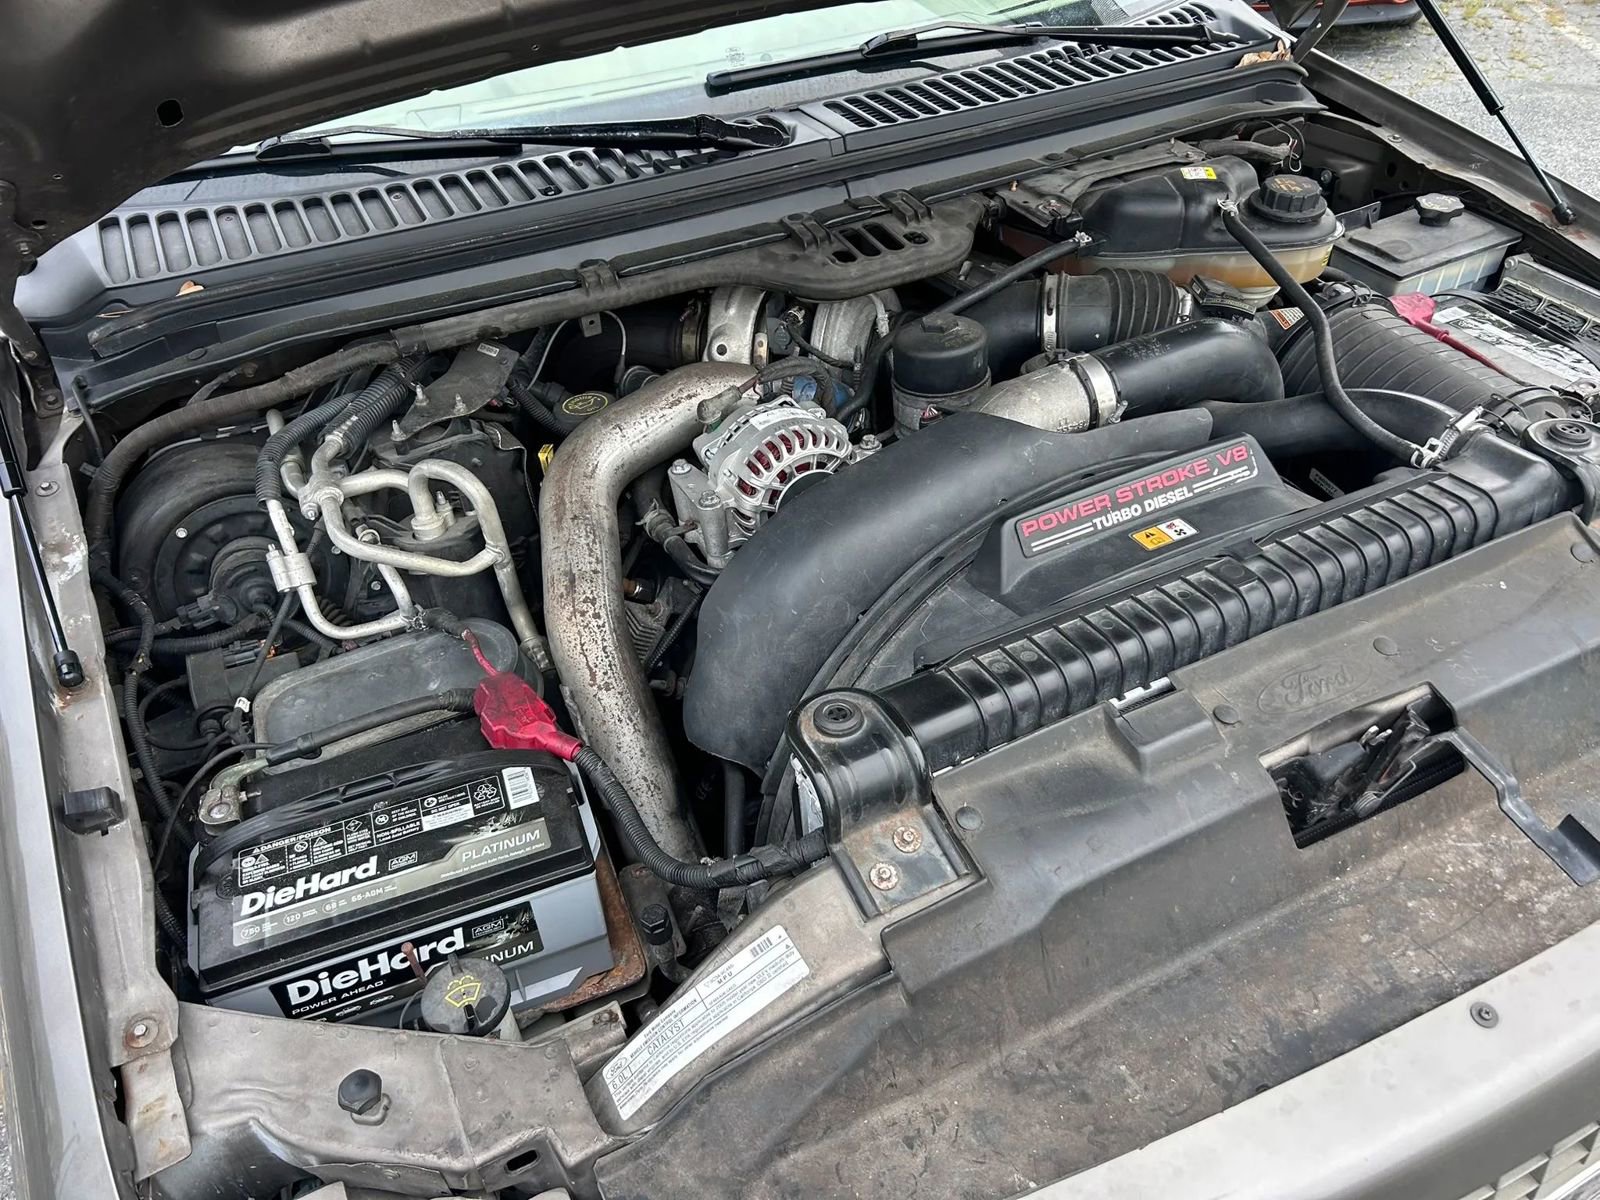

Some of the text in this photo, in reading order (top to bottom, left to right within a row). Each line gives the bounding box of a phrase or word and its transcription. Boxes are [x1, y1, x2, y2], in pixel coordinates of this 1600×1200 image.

[1020, 444, 1249, 538] POWER STROKE V8
[1092, 486, 1194, 531] TURBO DIESEL
[1281, 664, 1353, 705] Ford
[392, 854, 416, 865] AGM
[462, 829, 540, 862] PLATINUM
[474, 919, 505, 935] AGM
[292, 981, 384, 1015] POWER AHEAD
[645, 1018, 686, 1055] CATALYST
